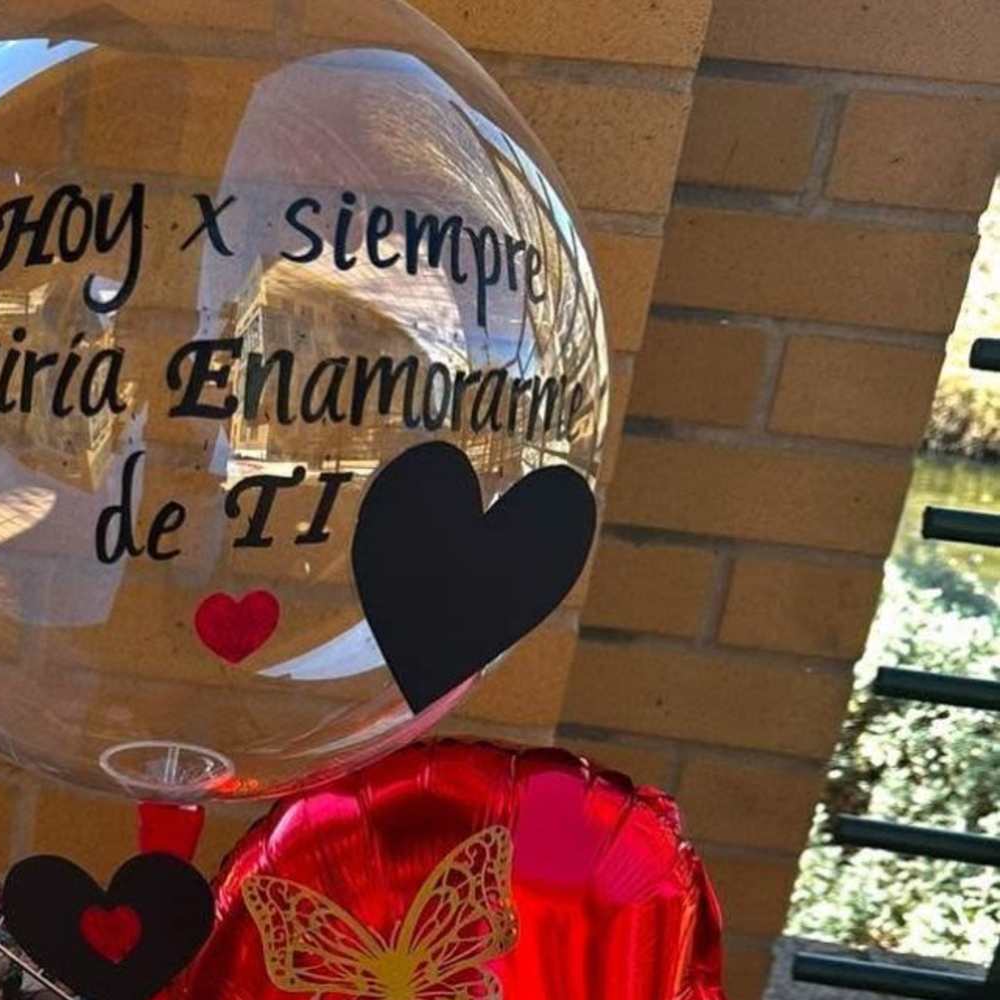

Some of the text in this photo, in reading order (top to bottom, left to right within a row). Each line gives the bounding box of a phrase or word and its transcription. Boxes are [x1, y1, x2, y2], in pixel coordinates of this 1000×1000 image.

[280, 191, 547, 328] siempre
[166, 337, 584, 442] Enamorarme
[95, 450, 353, 564] de TI
